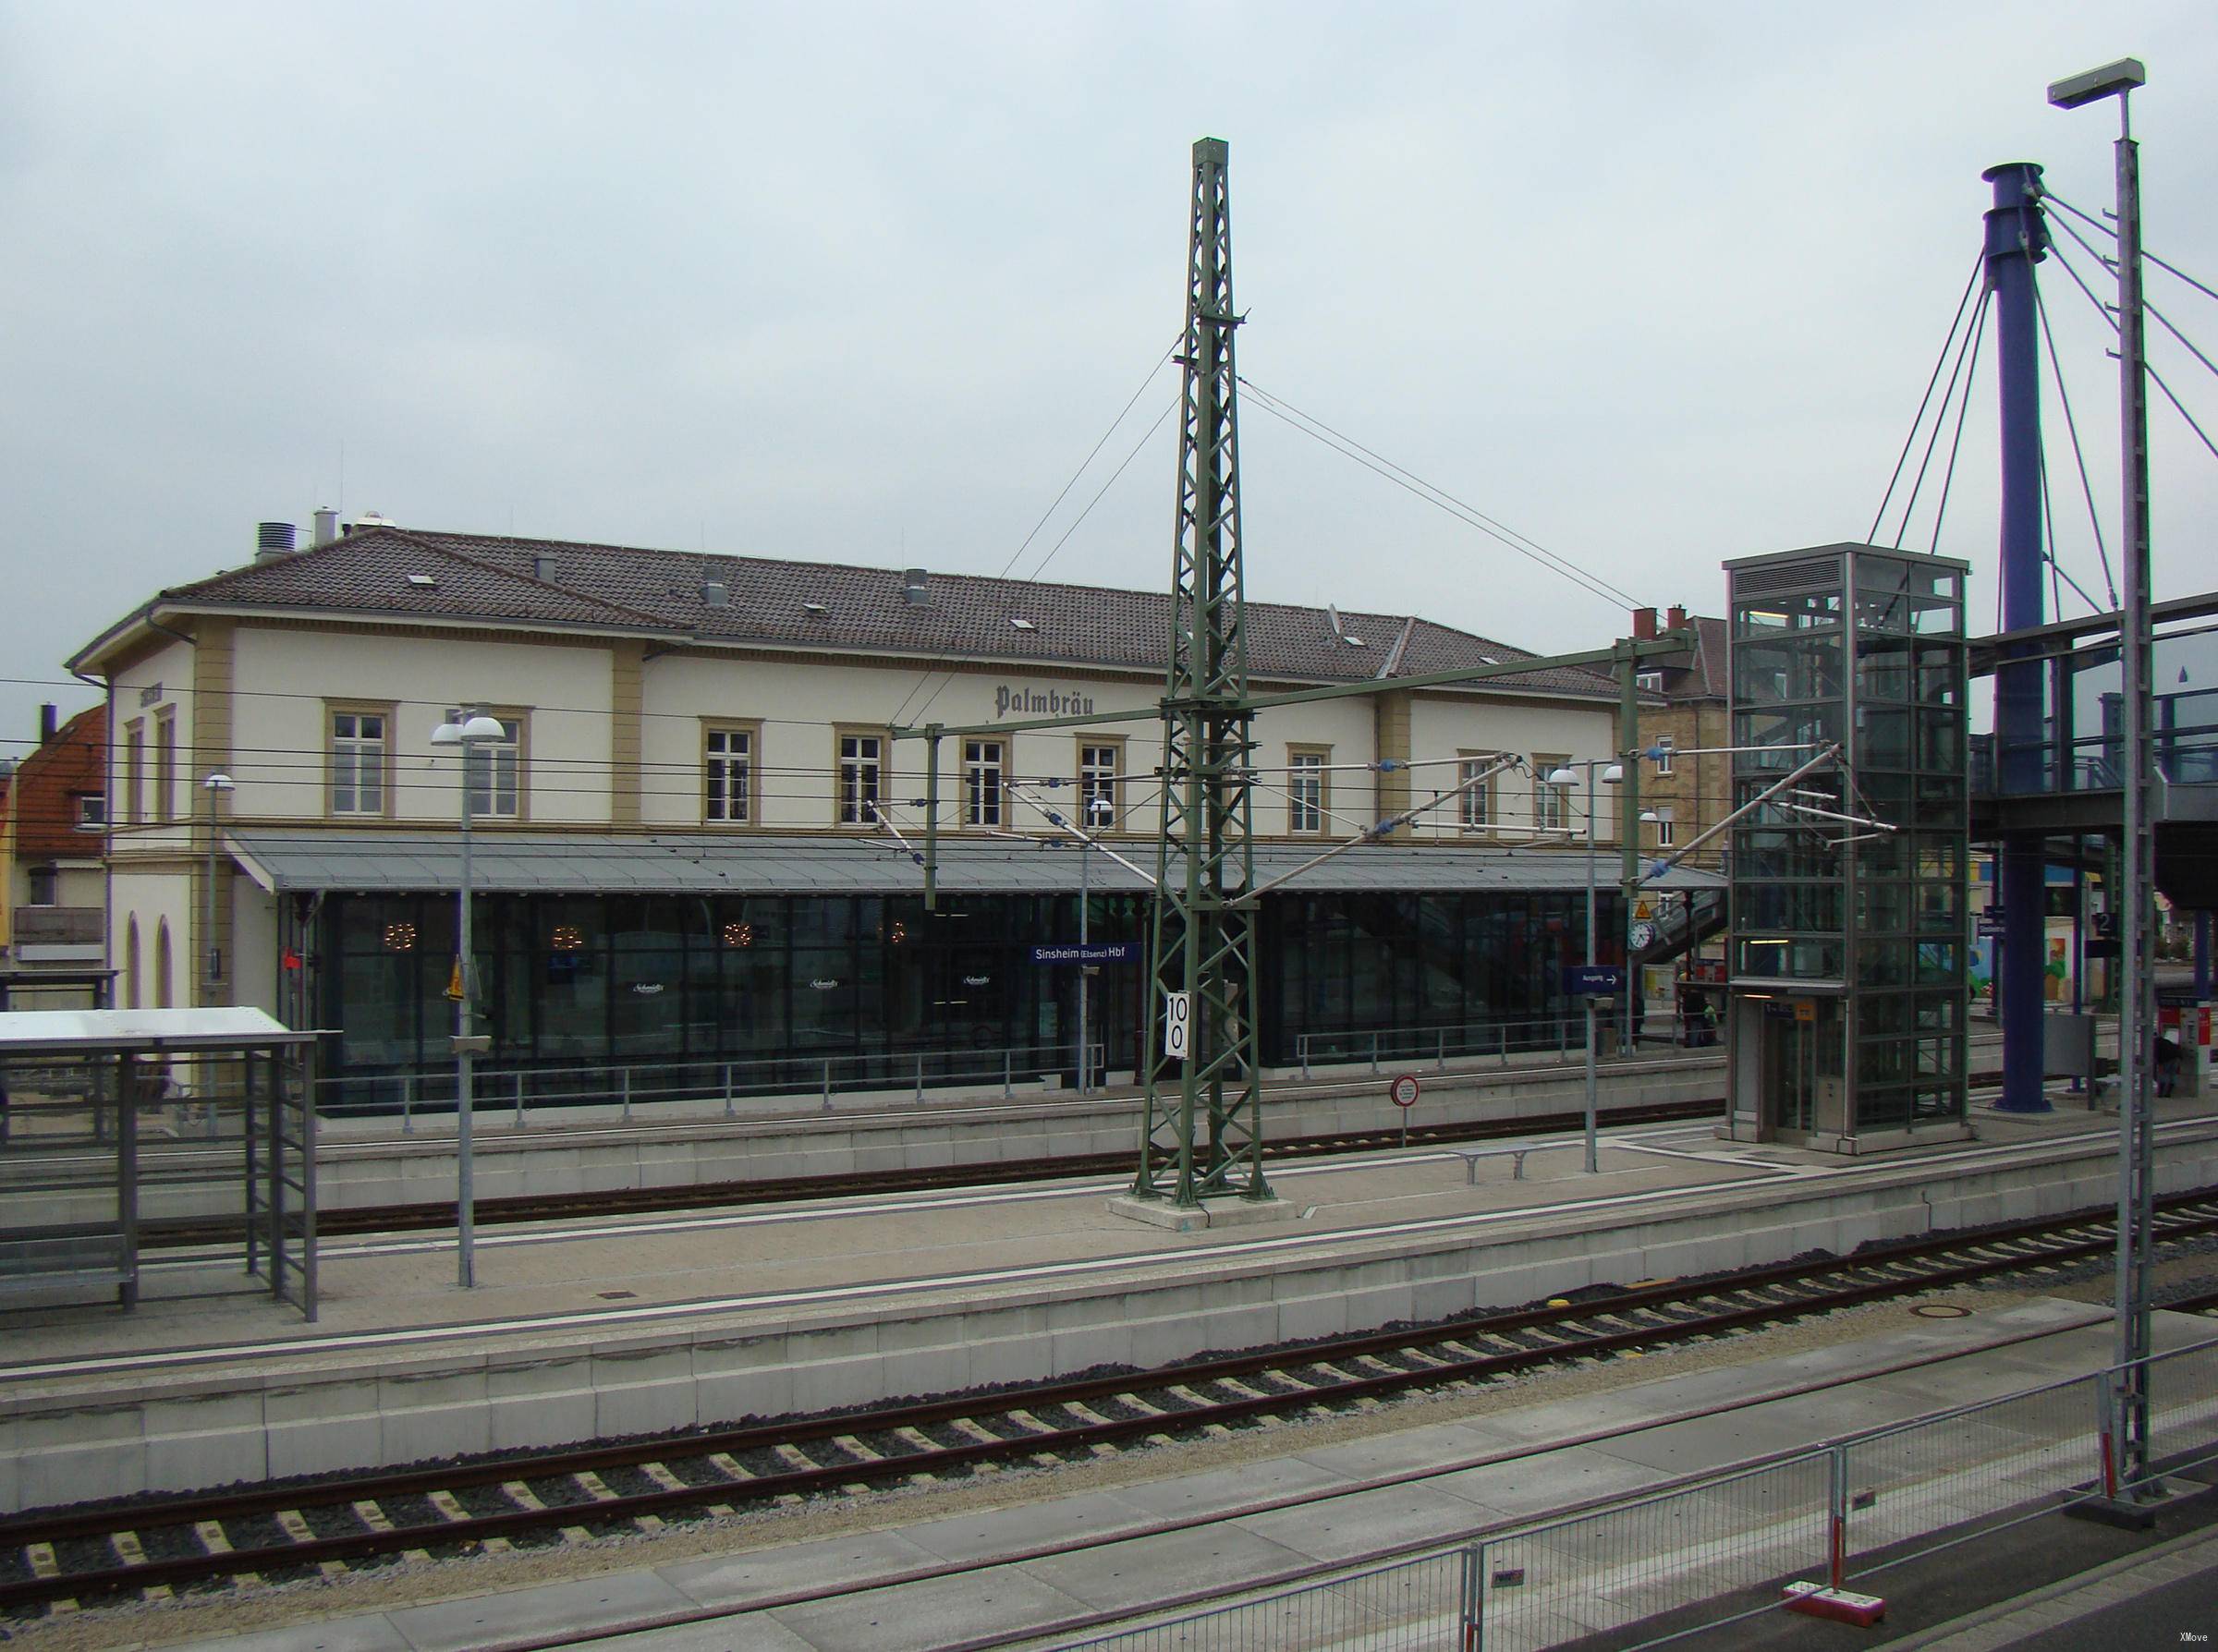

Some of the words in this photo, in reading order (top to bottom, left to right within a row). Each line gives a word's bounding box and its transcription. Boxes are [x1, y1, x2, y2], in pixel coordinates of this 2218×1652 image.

[994, 685, 1093, 719] Palmbräu
[1035, 948, 1079, 960] Sinsheim
[1080, 950, 1107, 958] (Elsenz)
[1108, 946, 1126, 957] Hbf
[1169, 997, 1188, 1022] 10
[1171, 1025, 1183, 1050] 0
